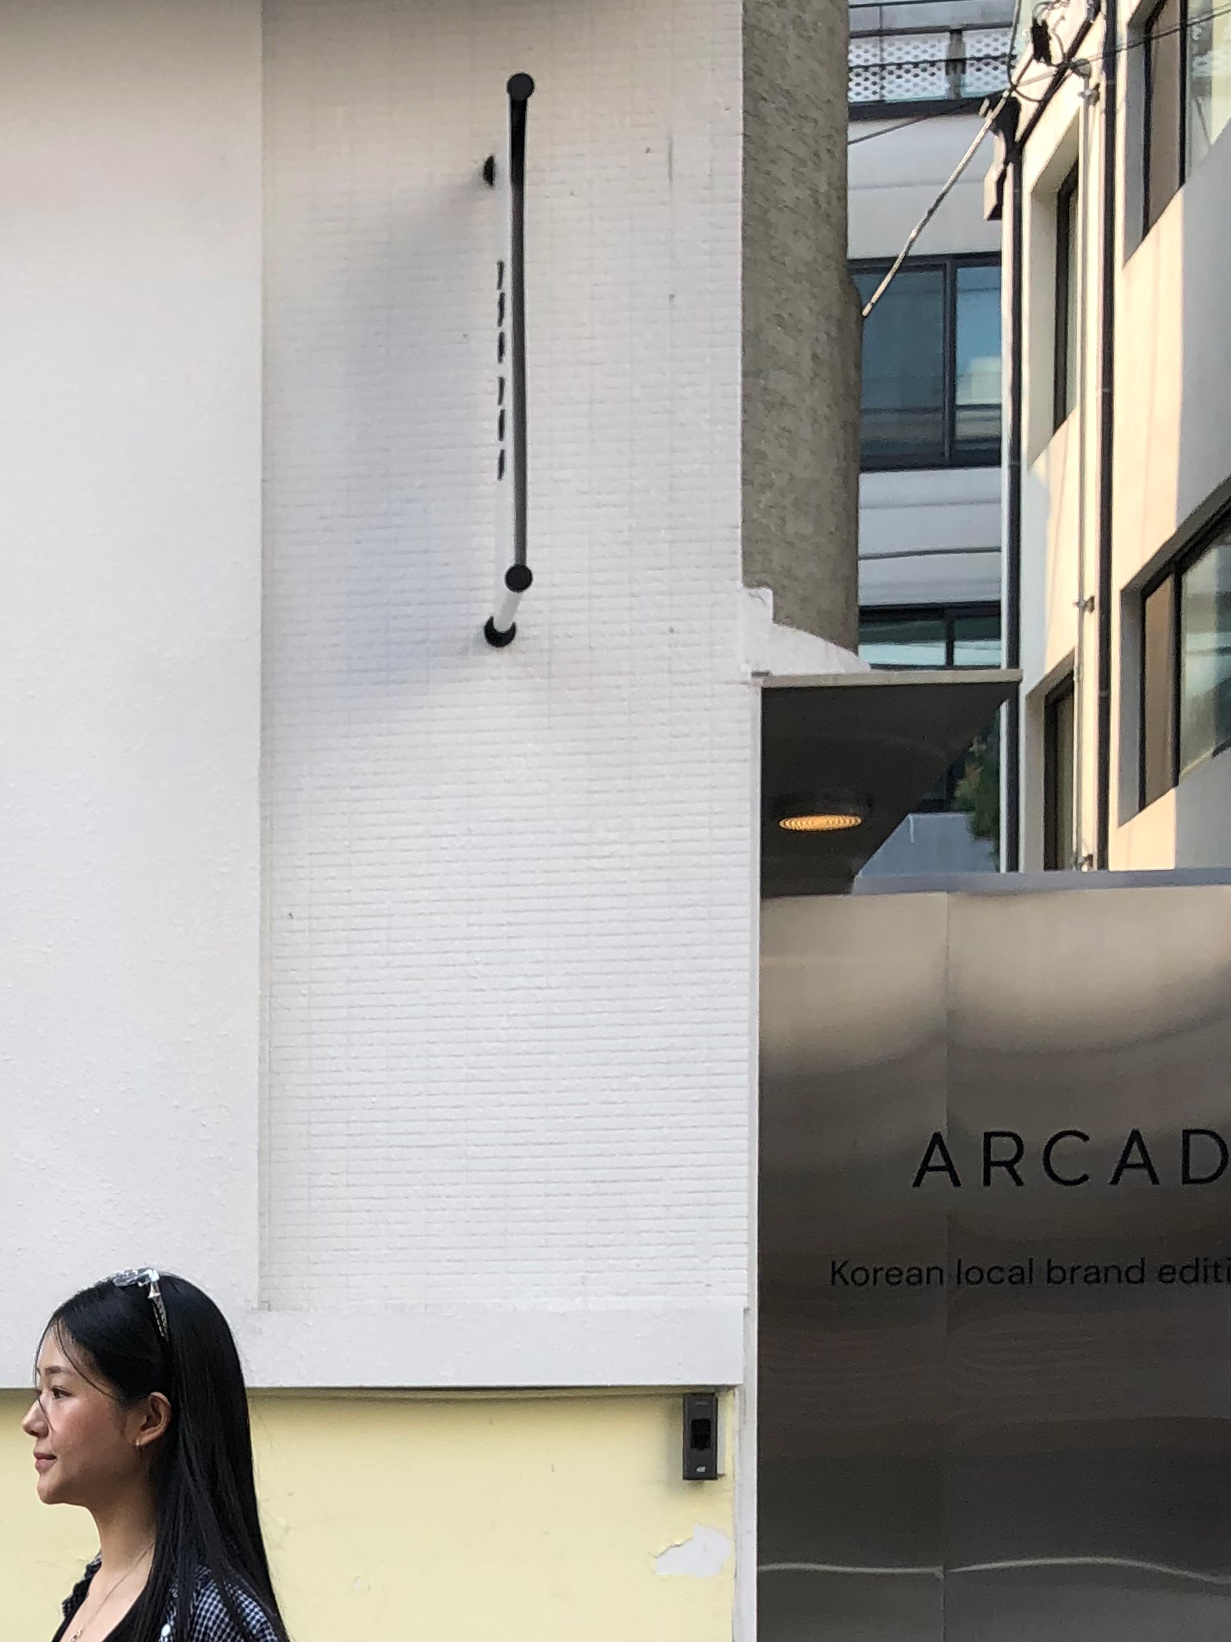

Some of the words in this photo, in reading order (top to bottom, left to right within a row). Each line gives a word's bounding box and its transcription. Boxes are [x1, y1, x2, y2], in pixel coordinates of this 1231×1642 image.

[911, 1128, 1230, 1187] ARCAD
[829, 1259, 945, 1287] Korean
[955, 1258, 1035, 1286] local
[1046, 1257, 1146, 1286] brand
